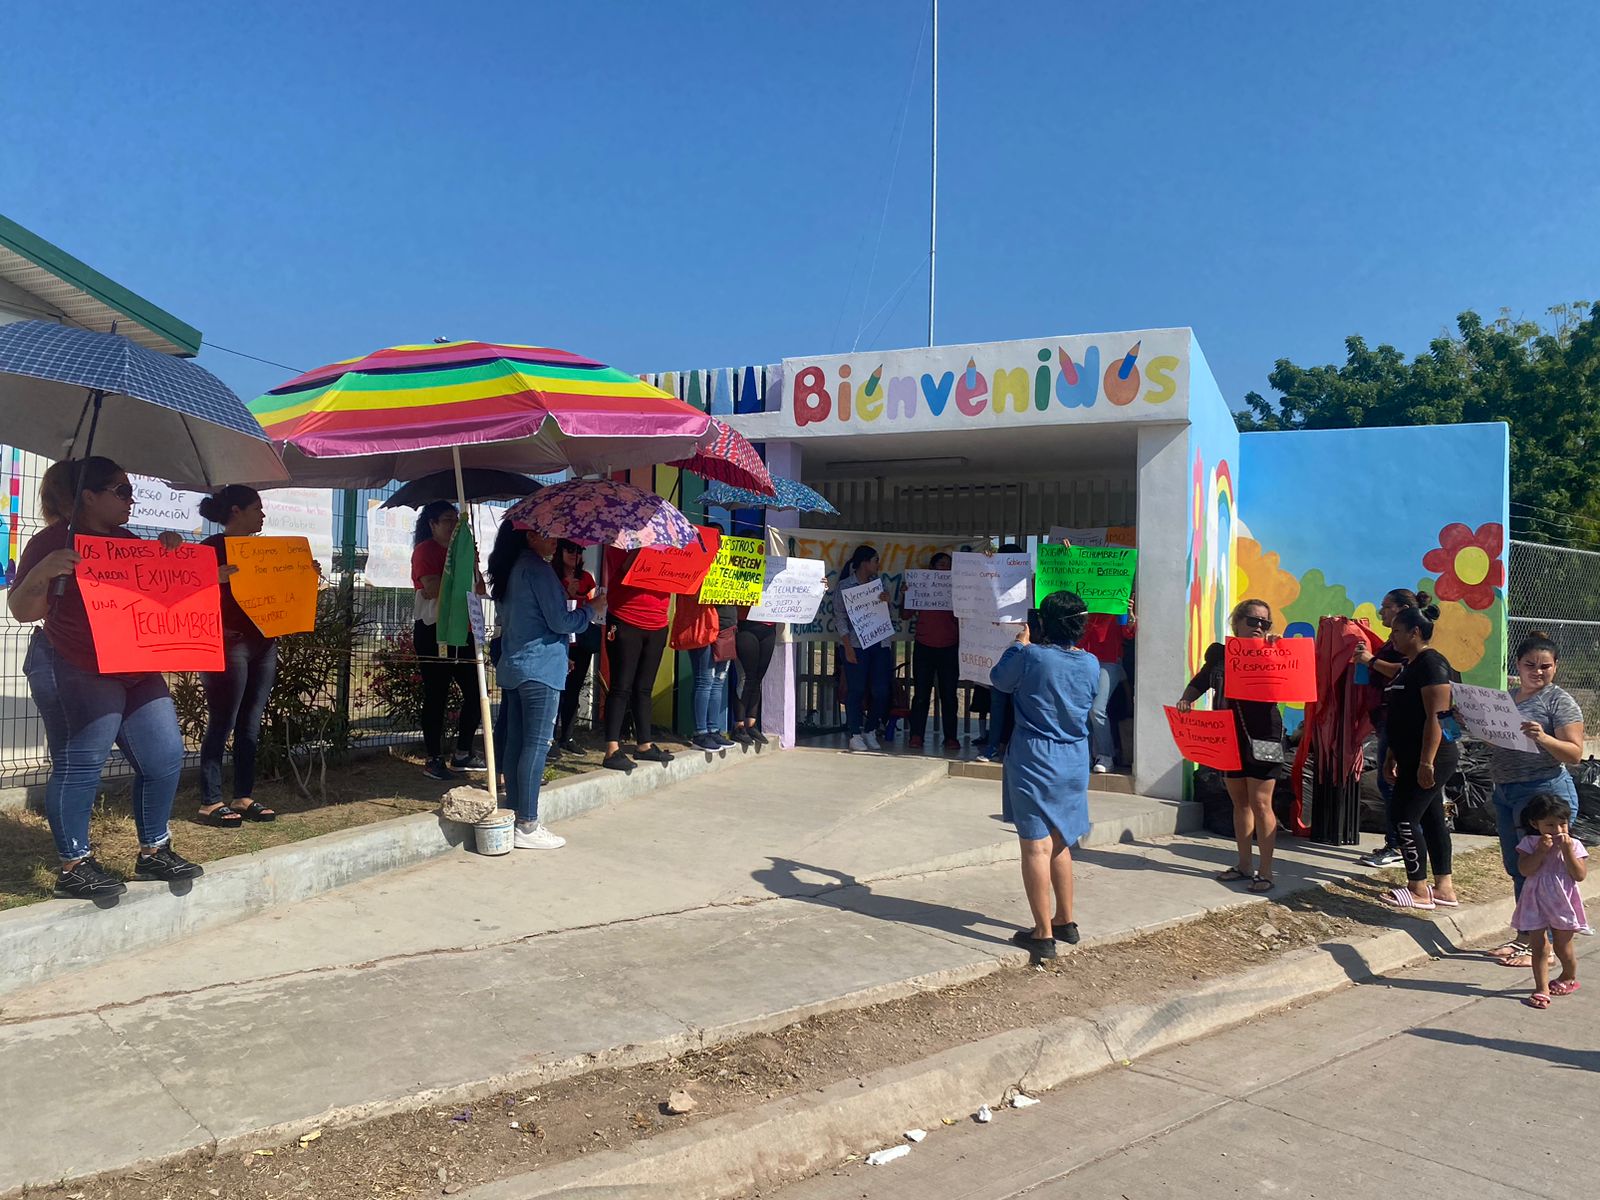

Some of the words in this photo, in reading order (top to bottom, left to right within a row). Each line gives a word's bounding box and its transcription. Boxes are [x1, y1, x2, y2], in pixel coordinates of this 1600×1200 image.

[793, 345, 1180, 427] Bienvenidos
[105, 541, 155, 560] PADRES
[174, 547, 198, 559] ESTE
[135, 564, 202, 594] EXIJIMOS
[719, 567, 762, 584] TECHUMBRE
[907, 572, 918, 580] NO
[1076, 581, 1128, 597] RESPUESTAS
[92, 599, 118, 610] UNA
[122, 599, 220, 641] TECHUMBRE!
[1228, 638, 1292, 658] QUEREMOS
[961, 652, 993, 668] DERECHO
[1229, 657, 1299, 673] RESPUESTA!!!
